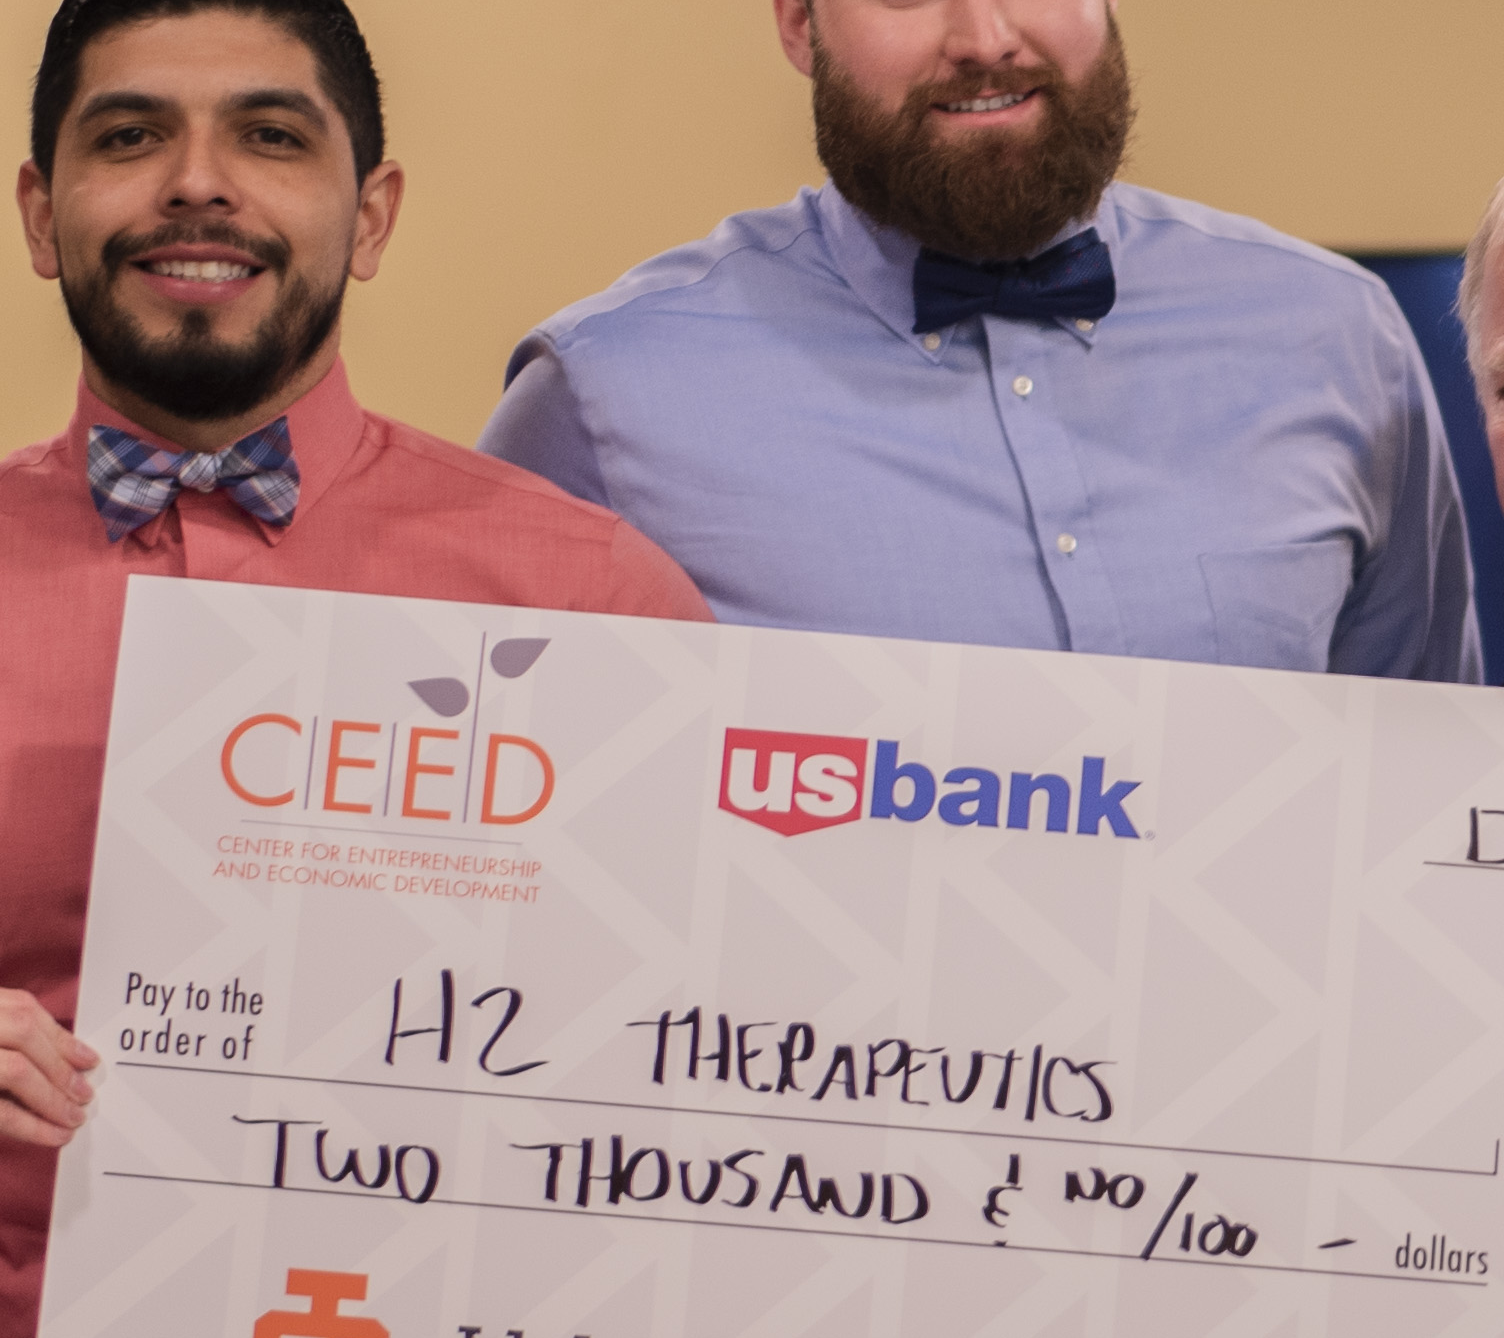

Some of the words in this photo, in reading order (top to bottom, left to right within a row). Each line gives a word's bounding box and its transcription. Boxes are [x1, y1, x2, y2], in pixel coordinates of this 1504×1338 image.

[221, 713, 555, 825] CEED
[216, 834, 294, 859] CENTER
[300, 841, 341, 862] FOR
[347, 845, 543, 879] ENTREPRENEURSHIP
[212, 860, 261, 881] AND
[267, 865, 388, 892] ECONOMIC
[394, 874, 541, 904] DEVELOPMENT
[124, 972, 175, 1016] Pay
[184, 980, 210, 1012] to
[221, 977, 264, 1016] the
[119, 1018, 207, 1059] order
[222, 1023, 256, 1062] of
[384, 968, 549, 1076] H2
[625, 1005, 1118, 1122] THERAPEUTICS
[231, 1113, 440, 1203] TWO
[507, 1134, 932, 1223] THOUSAND
[1395, 1231, 1490, 1276] dollars
